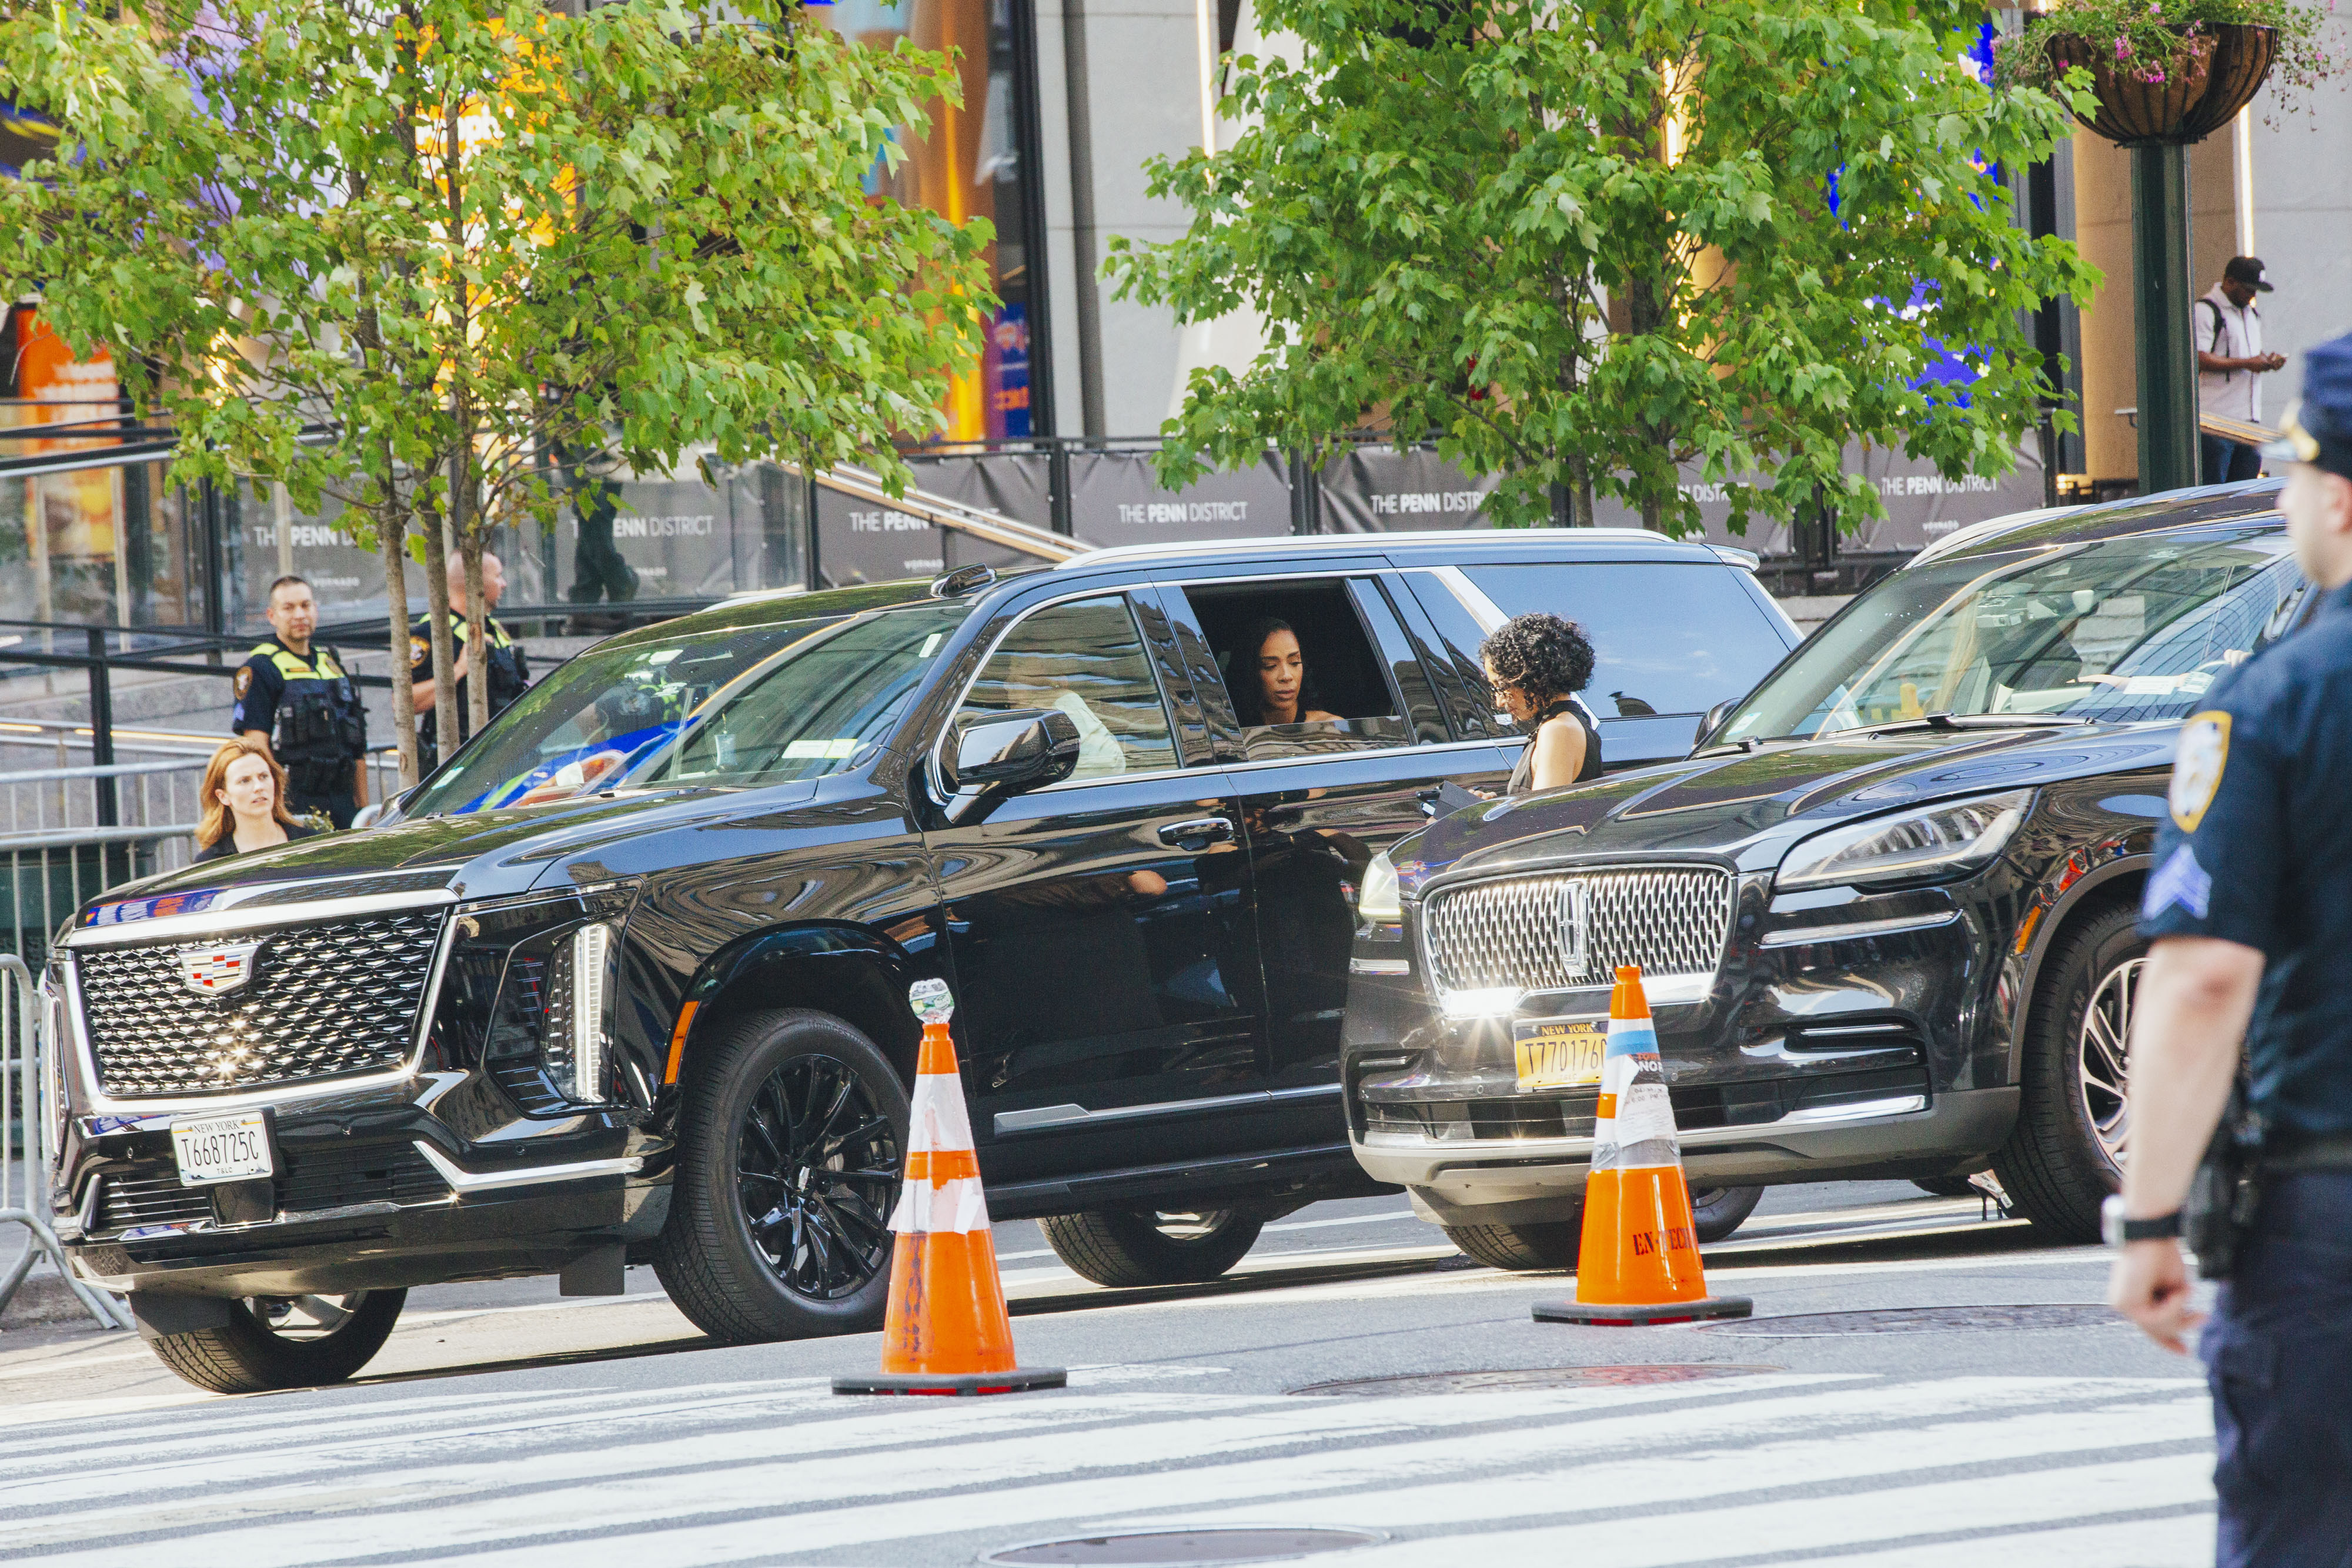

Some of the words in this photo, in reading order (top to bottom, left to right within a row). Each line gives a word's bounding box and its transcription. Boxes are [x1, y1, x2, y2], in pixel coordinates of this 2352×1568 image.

[1882, 476, 1904, 496] THE
[1906, 475, 1943, 495] PENN
[1118, 503, 1145, 524] THE
[1147, 503, 1187, 523] PENN
[1189, 501, 1248, 522] DISTRICT
[1370, 494, 1398, 514] THE
[1399, 493, 1441, 513] PENN
[612, 517, 647, 538] ENN
[649, 515, 713, 537] DISTRICT
[849, 511, 881, 532] THE
[254, 526, 278, 547] TH
[290, 525, 339, 547] PENN
[1541, 1025, 1566, 1036] NEW
[1566, 1022, 1594, 1034] YORK
[193, 1124, 214, 1134] NEW
[215, 1119, 240, 1132] YORK
[181, 1131, 259, 1168] T668725C
